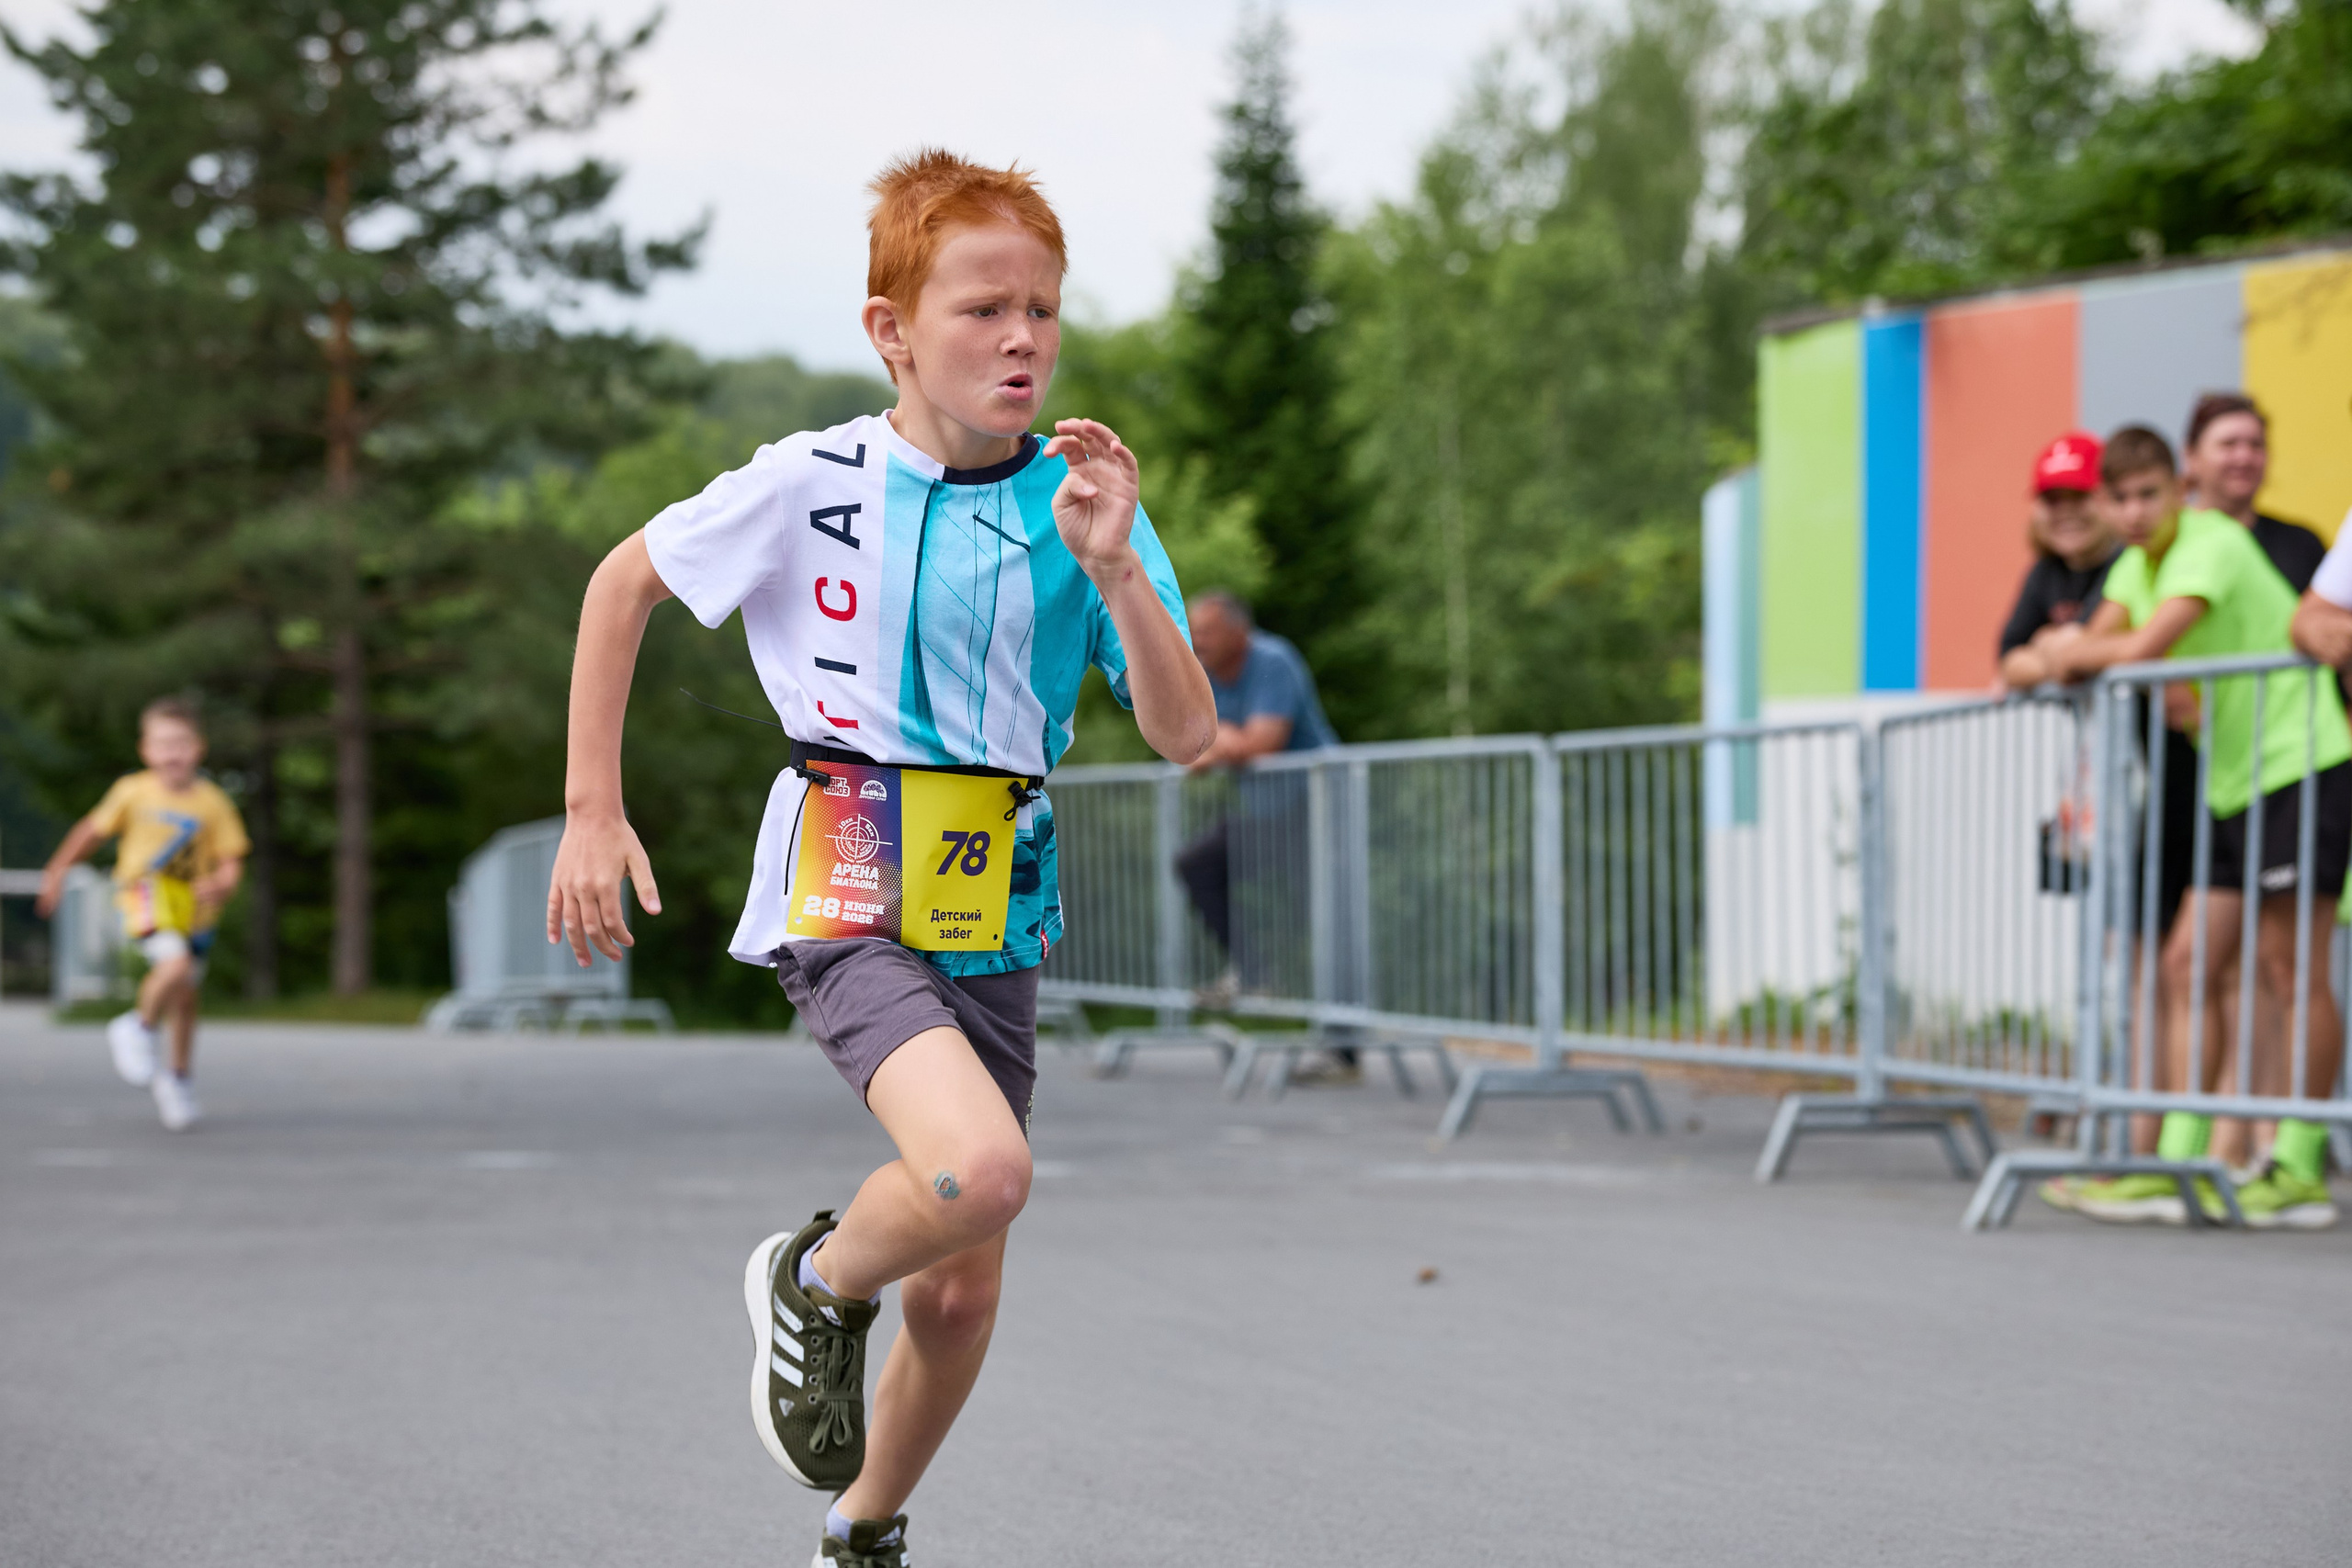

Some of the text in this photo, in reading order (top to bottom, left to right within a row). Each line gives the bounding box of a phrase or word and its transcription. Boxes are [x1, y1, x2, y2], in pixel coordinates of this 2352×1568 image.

[809, 443, 866, 746] TICAL
[936, 830, 990, 876] 78
[831, 862, 879, 880] АРЕНА
[830, 875, 878, 890] БИАТЛОНА
[802, 895, 885, 919] 28 ИЮНЯ
[842, 912, 875, 925] 2026
[930, 908, 982, 923] Детский
[939, 927, 973, 940] забег
